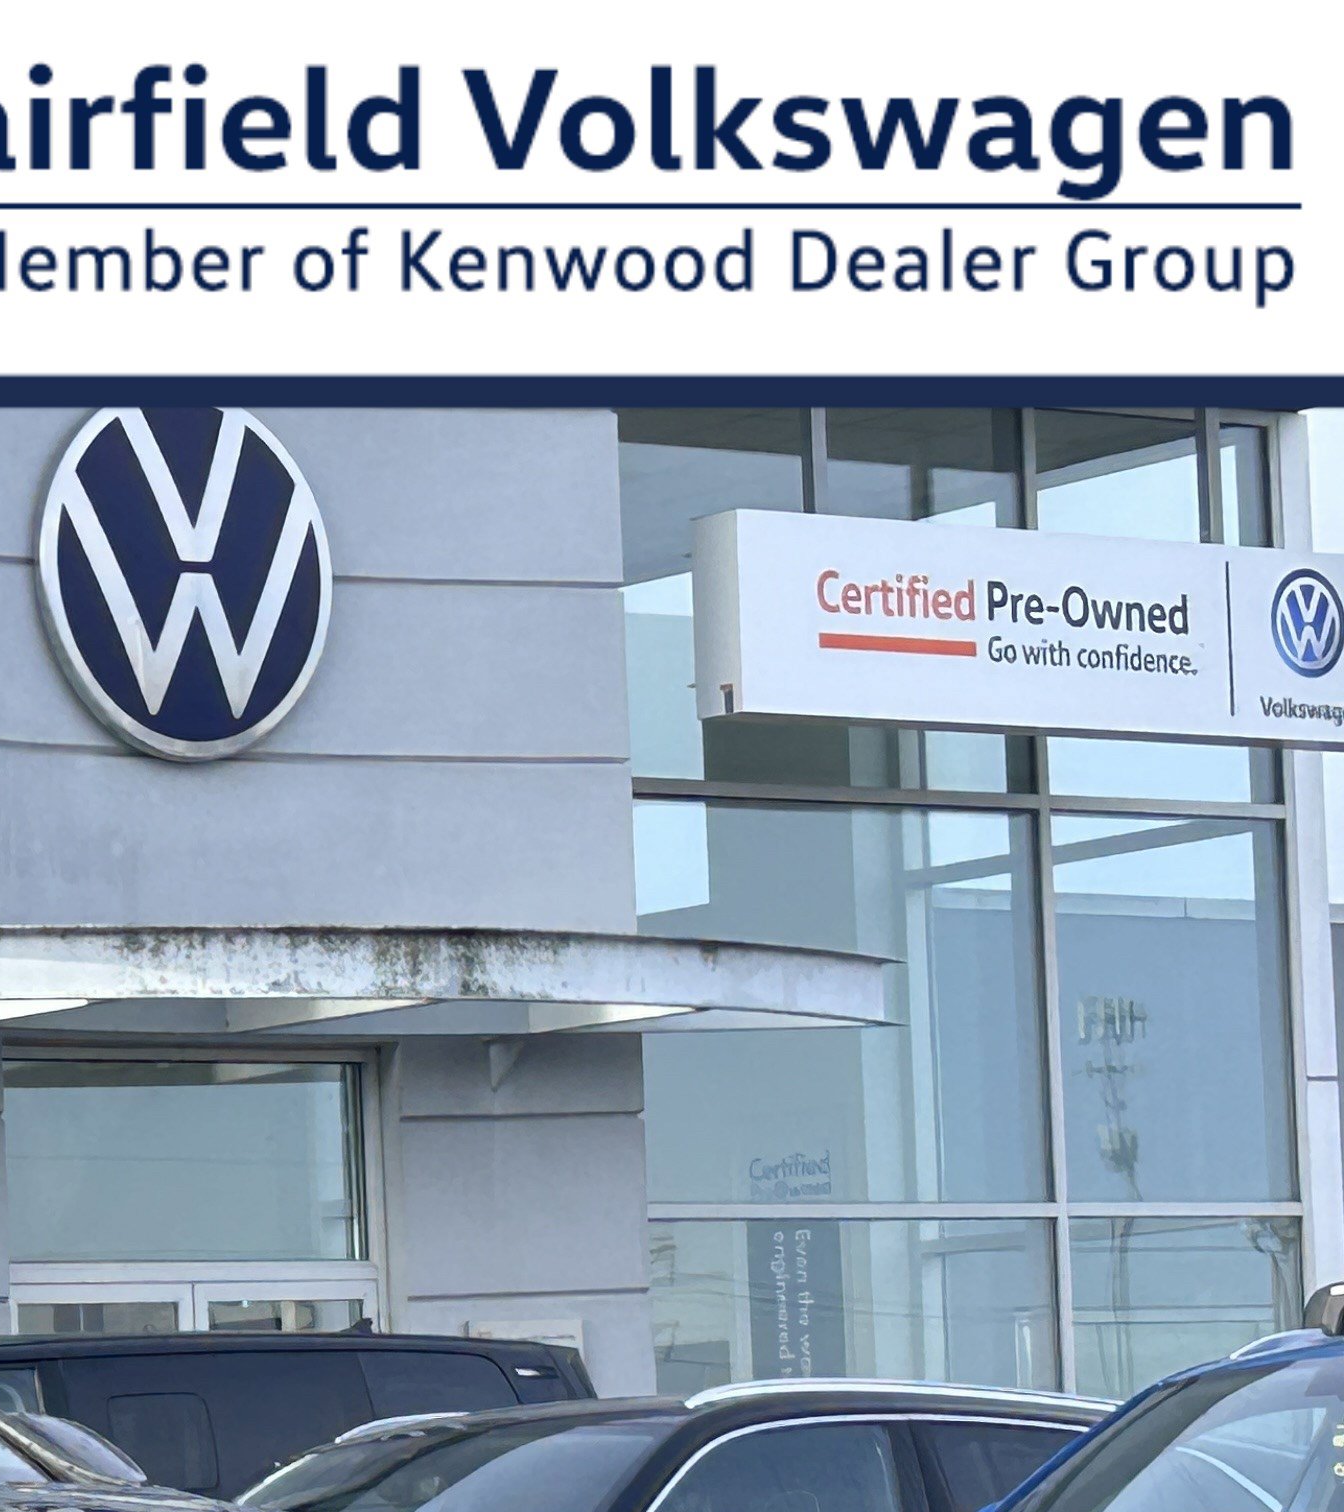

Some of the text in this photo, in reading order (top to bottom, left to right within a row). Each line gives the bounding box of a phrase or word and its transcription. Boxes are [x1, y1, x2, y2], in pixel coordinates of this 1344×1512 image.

[817, 569, 1189, 635] Certified Pre-Owned
[988, 635, 1198, 676] Go with confidence.
[1260, 695, 1344, 727] Volkswag
